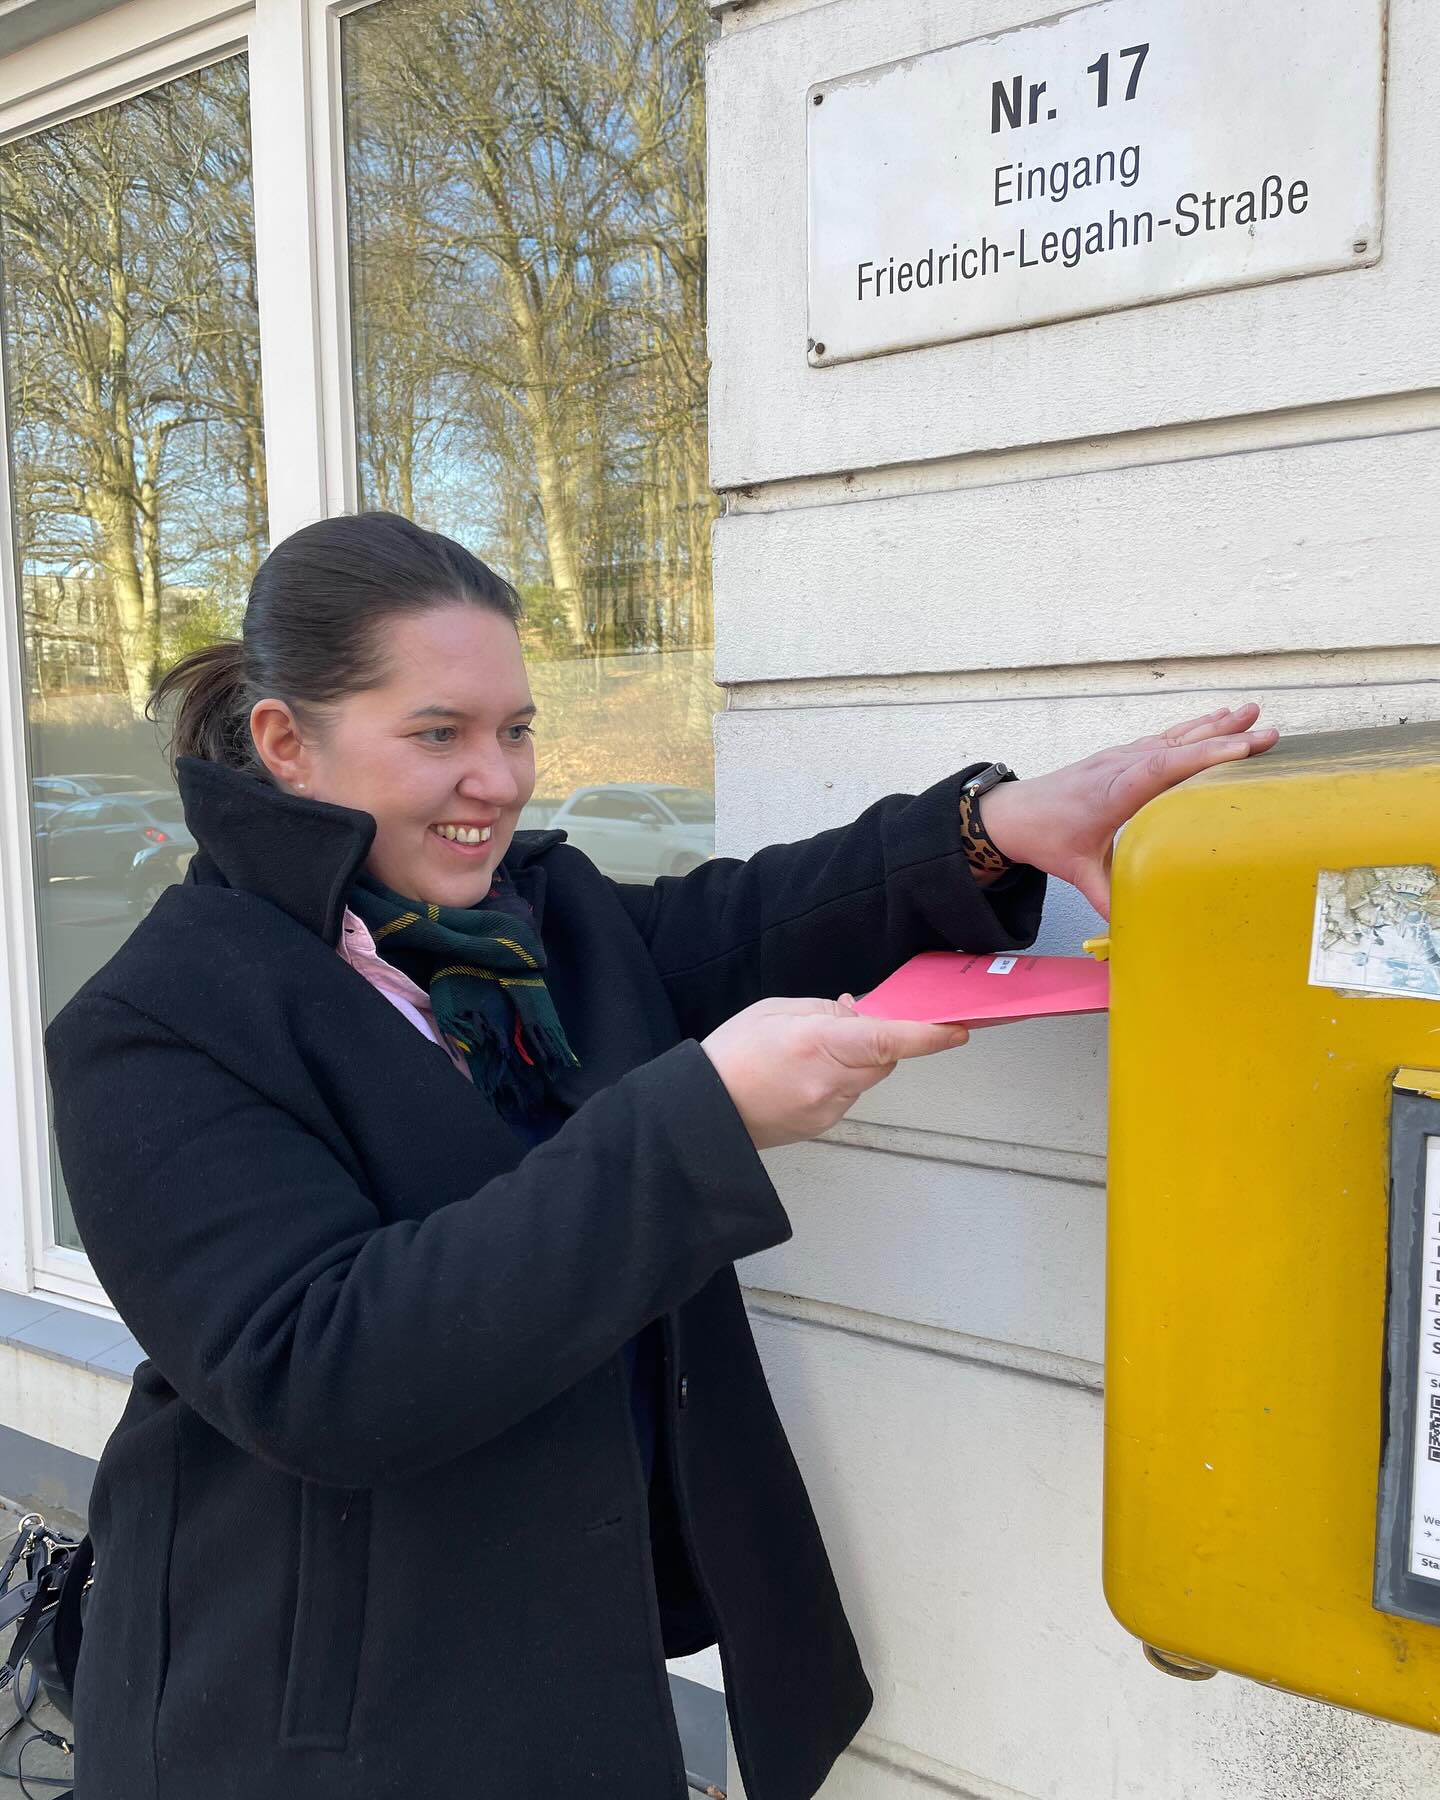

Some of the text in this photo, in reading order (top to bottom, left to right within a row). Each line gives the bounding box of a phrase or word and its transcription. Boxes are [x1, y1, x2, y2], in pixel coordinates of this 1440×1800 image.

[991, 43, 1150, 133] Nr. 17
[994, 145, 1140, 207] Eingang
[857, 175, 1309, 301] Friedrich-Legahn-Straße
[1430, 1378, 1440, 1389] S
[1421, 1557, 1440, 1570] Sta
